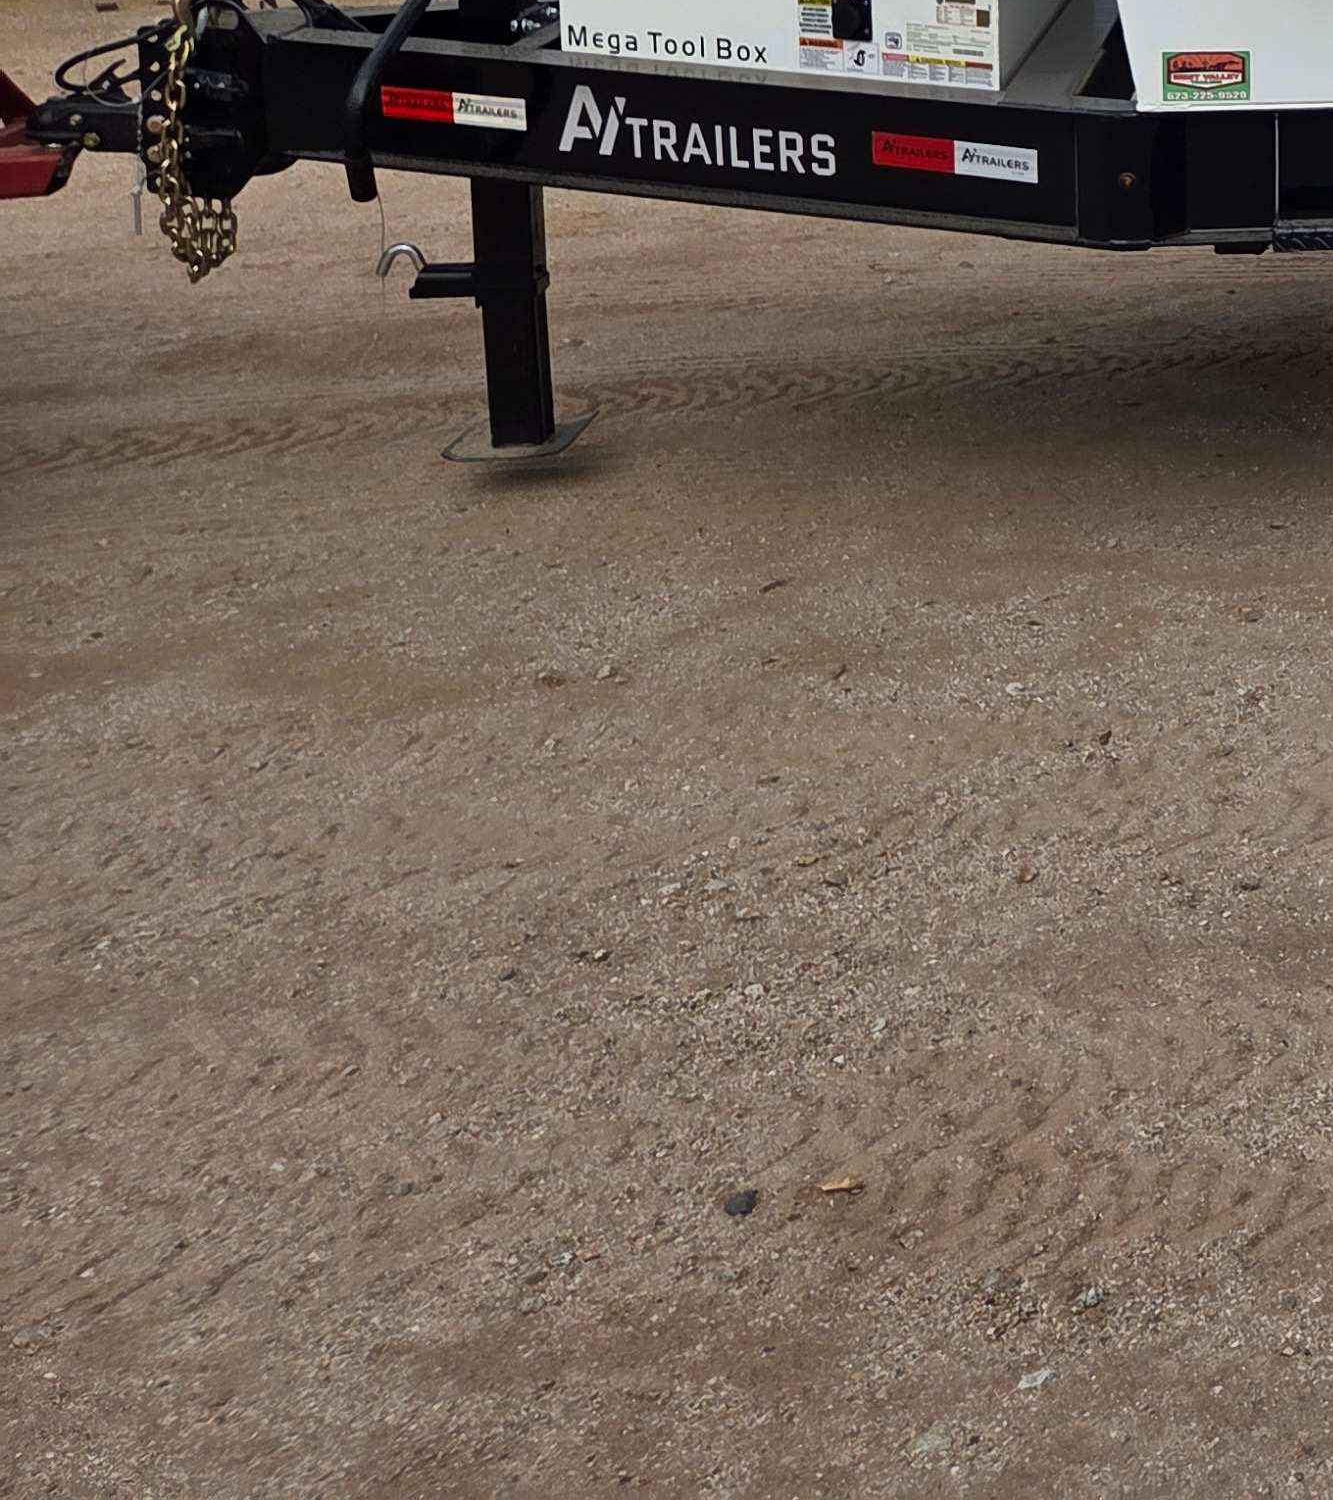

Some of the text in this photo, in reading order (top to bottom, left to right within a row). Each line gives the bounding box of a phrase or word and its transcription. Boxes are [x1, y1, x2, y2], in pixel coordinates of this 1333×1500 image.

[568, 24, 638, 54] Mega
[648, 31, 705, 59] Tool
[717, 38, 767, 64] Box
